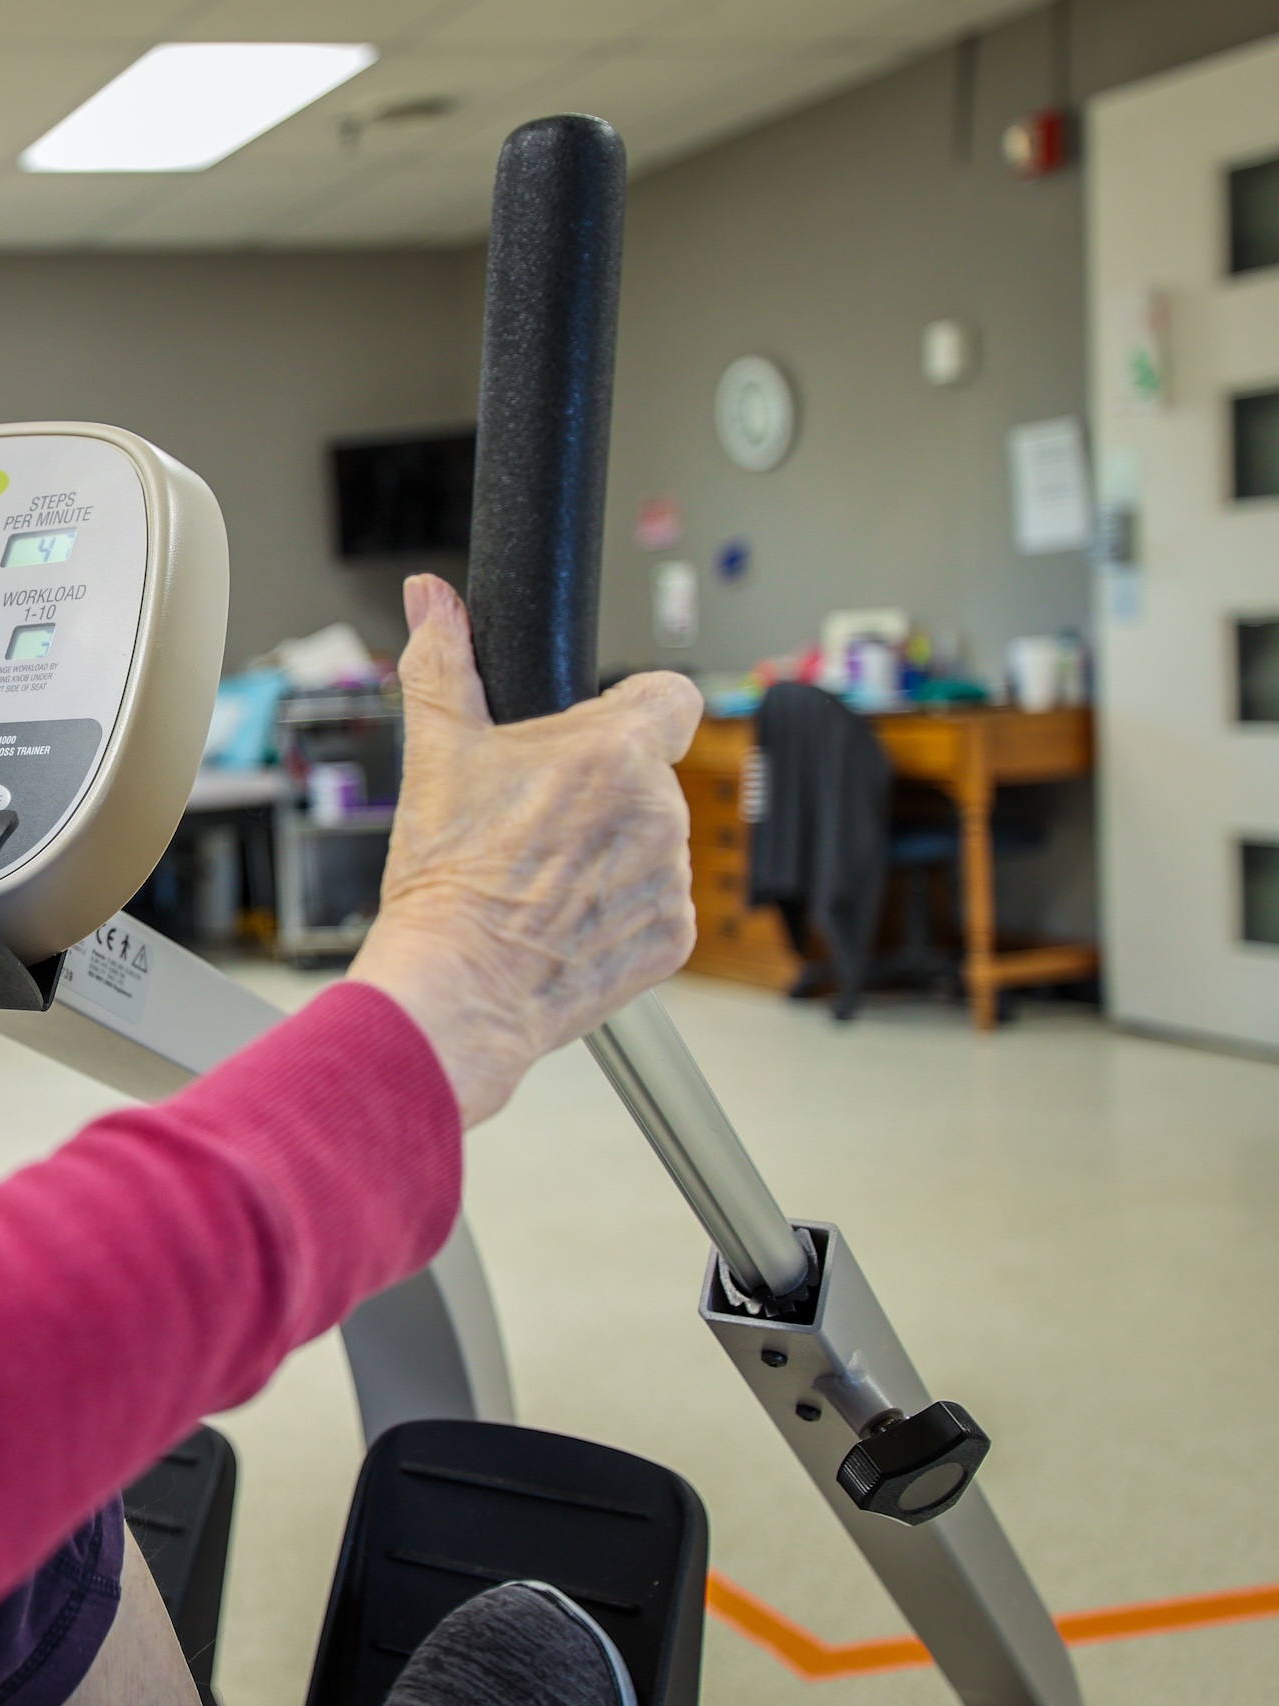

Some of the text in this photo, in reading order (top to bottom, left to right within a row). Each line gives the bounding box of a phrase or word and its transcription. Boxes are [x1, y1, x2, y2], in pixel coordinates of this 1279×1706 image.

[29, 491, 77, 512] STEPS
[3, 505, 94, 531] PER MINUTE
[3, 584, 87, 607] WORKLOAD
[24, 604, 57, 621] 1-10
[12, 662, 49, 673] WORKLOAD
[49, 662, 59, 670] BY
[11, 674, 30, 682] KNOB
[30, 672, 53, 681] UNDER
[5, 684, 20, 693] SIDE
[21, 683, 31, 692] OF
[30, 682, 47, 691] SEAT
[16, 745, 51, 756] TRAINER
